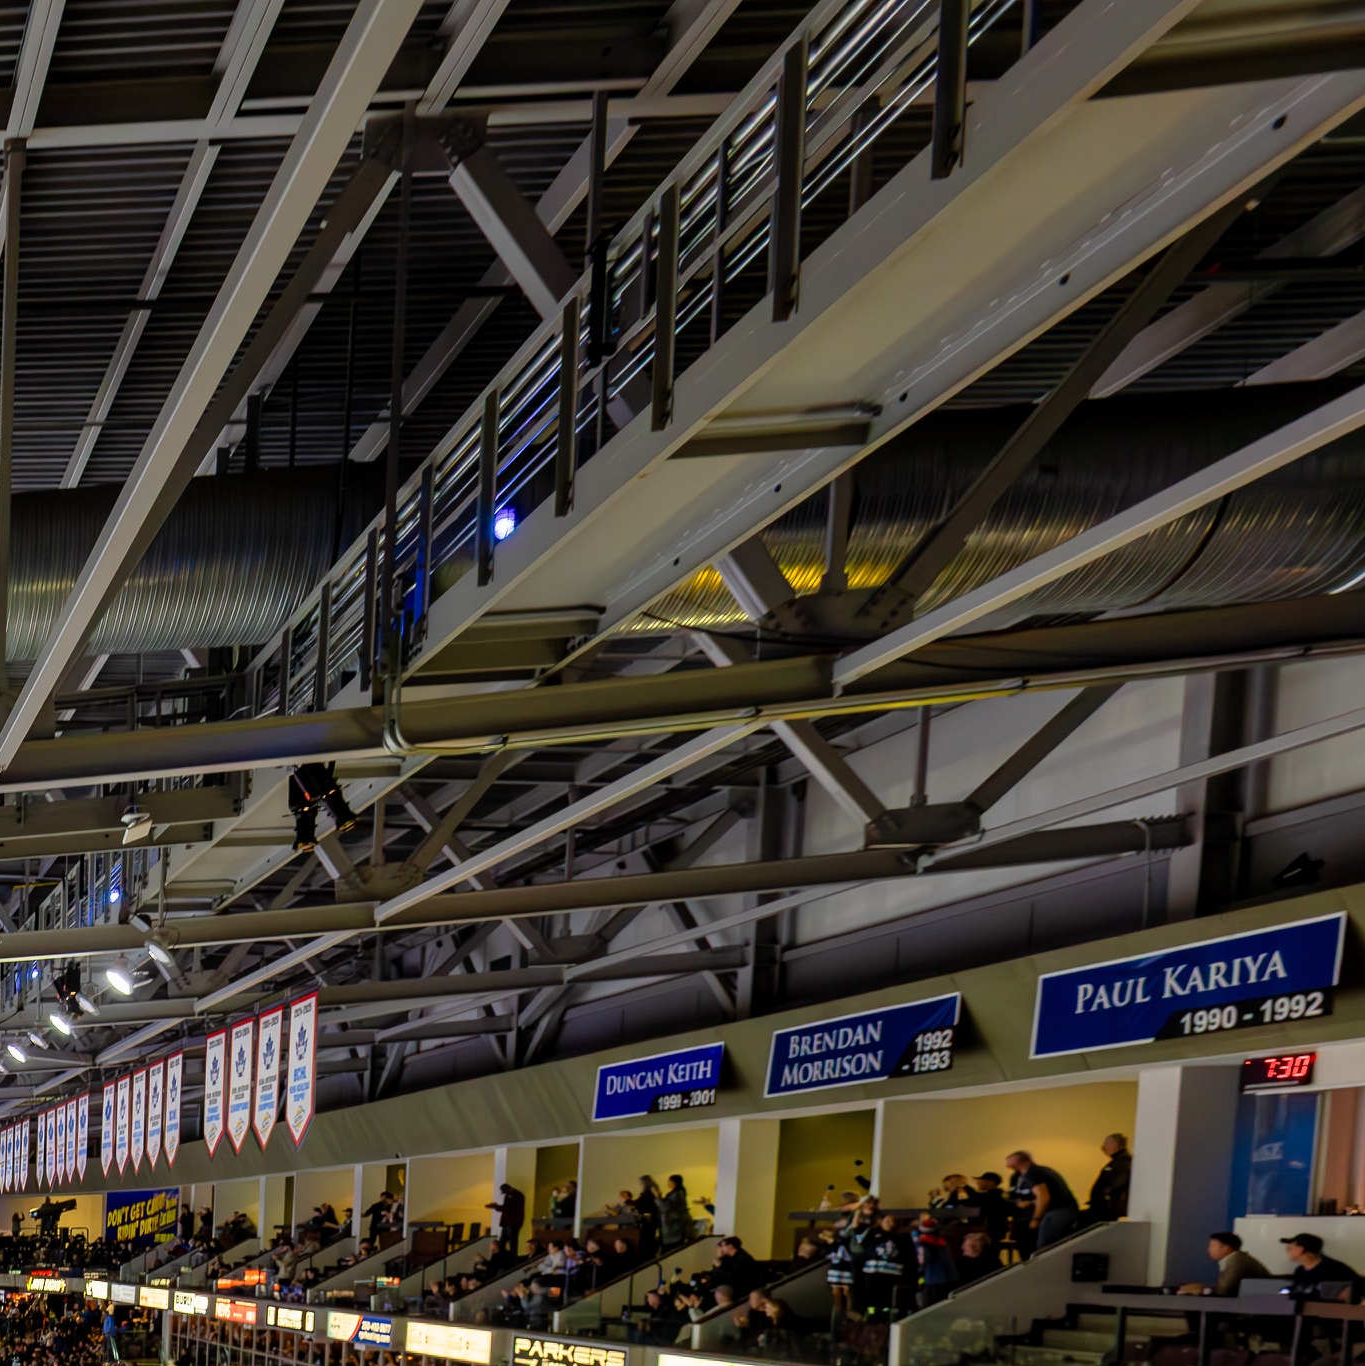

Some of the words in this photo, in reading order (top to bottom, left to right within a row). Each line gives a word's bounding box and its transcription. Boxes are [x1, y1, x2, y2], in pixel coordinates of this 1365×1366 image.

[1075, 977, 1151, 1014] PAUL
[1162, 951, 1287, 999] KARIYA
[1180, 1005, 1236, 1034] 1990
[1260, 991, 1323, 1023] 1992
[788, 1021, 883, 1059] BRENDAN
[915, 1029, 953, 1052] 1992
[606, 1068, 664, 1096] DUNCAN
[667, 1059, 712, 1084] KEITH
[780, 1050, 883, 1087] MORRISON
[912, 1050, 951, 1073] 1993
[1265, 1055, 1311, 1078] 7:30
[107, 1206, 129, 1228] DON'T
[131, 1201, 145, 1221] GET
